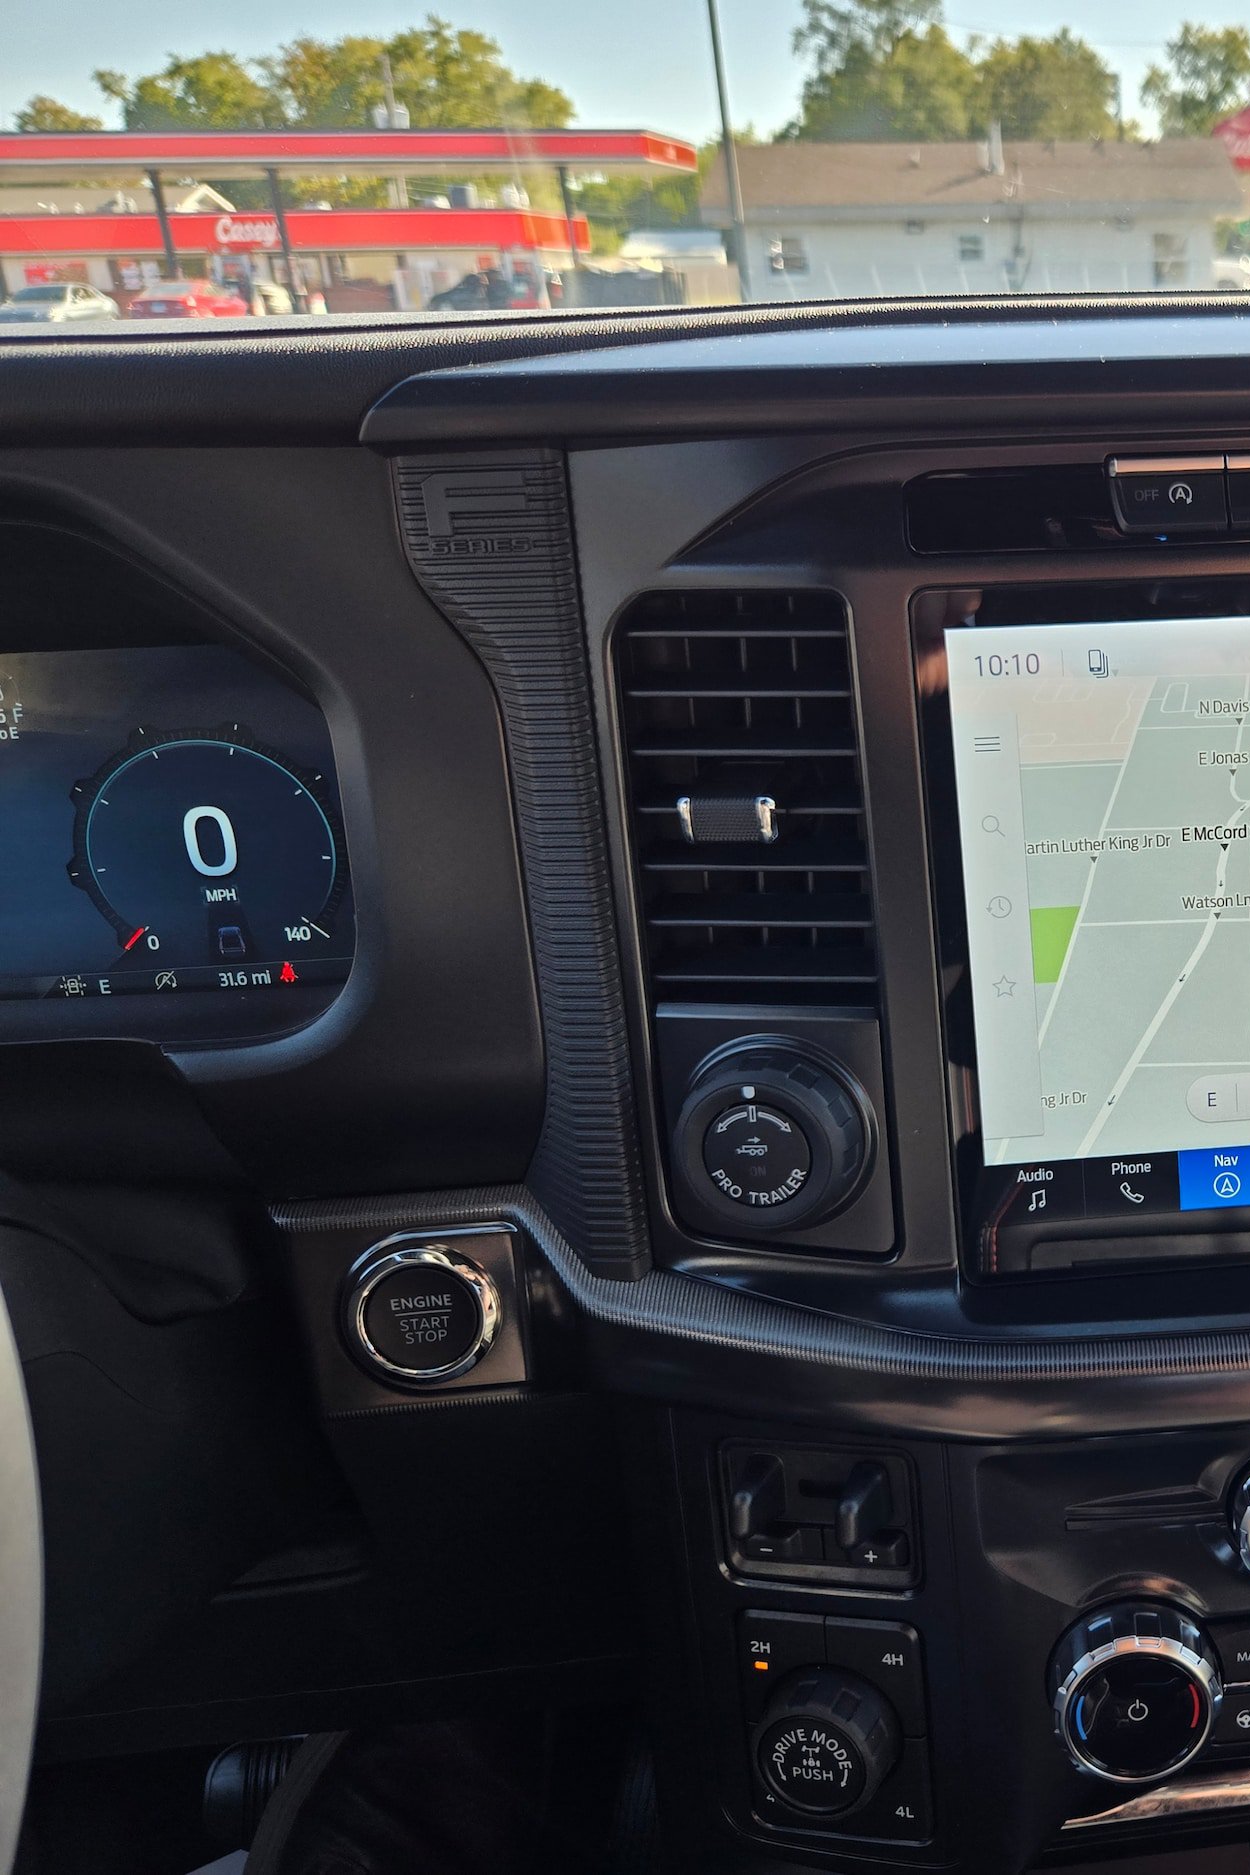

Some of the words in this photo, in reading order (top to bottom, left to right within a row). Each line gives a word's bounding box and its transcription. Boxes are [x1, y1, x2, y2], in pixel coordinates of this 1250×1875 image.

[431, 538, 530, 555] SERIES
[973, 652, 1041, 677] 10:10
[1200, 701, 1210, 714] N
[1214, 699, 1250, 714] Davis
[1199, 752, 1206, 766] E
[1210, 750, 1248, 765] Jonas
[1182, 828, 1190, 842] E
[1194, 824, 1247, 842] McCord
[183, 806, 238, 877] 0
[1062, 838, 1106, 853] Luther
[1110, 836, 1138, 852] King
[1142, 836, 1154, 848] Jr
[1156, 834, 1171, 848] Dr
[205, 888, 237, 903] MPH
[1182, 894, 1233, 910] Watson
[284, 926, 312, 942] 140
[147, 935, 160, 950] 0
[218, 972, 248, 988] 31.6
[252, 970, 272, 986] mi
[99, 980, 112, 995] E
[1060, 1092, 1070, 1106] Jr
[1072, 1092, 1087, 1104] Dr
[1207, 1092, 1217, 1106] E
[1111, 1160, 1152, 1176] Phone
[1214, 1154, 1239, 1168] Nav
[1016, 1168, 1054, 1183] Audio
[712, 1168, 743, 1198] PRO
[749, 1168, 807, 1206] TRAILER
[390, 1294, 452, 1311] ENGINE
[400, 1316, 450, 1332] START
[406, 1330, 448, 1344] STOP
[750, 1640, 771, 1654] 2H
[882, 1653, 904, 1666] 4H
[772, 1728, 807, 1764] DRIVE
[811, 1730, 852, 1770] MODE
[792, 1766, 834, 1782] PUSH
[894, 1806, 915, 1818] 4L
